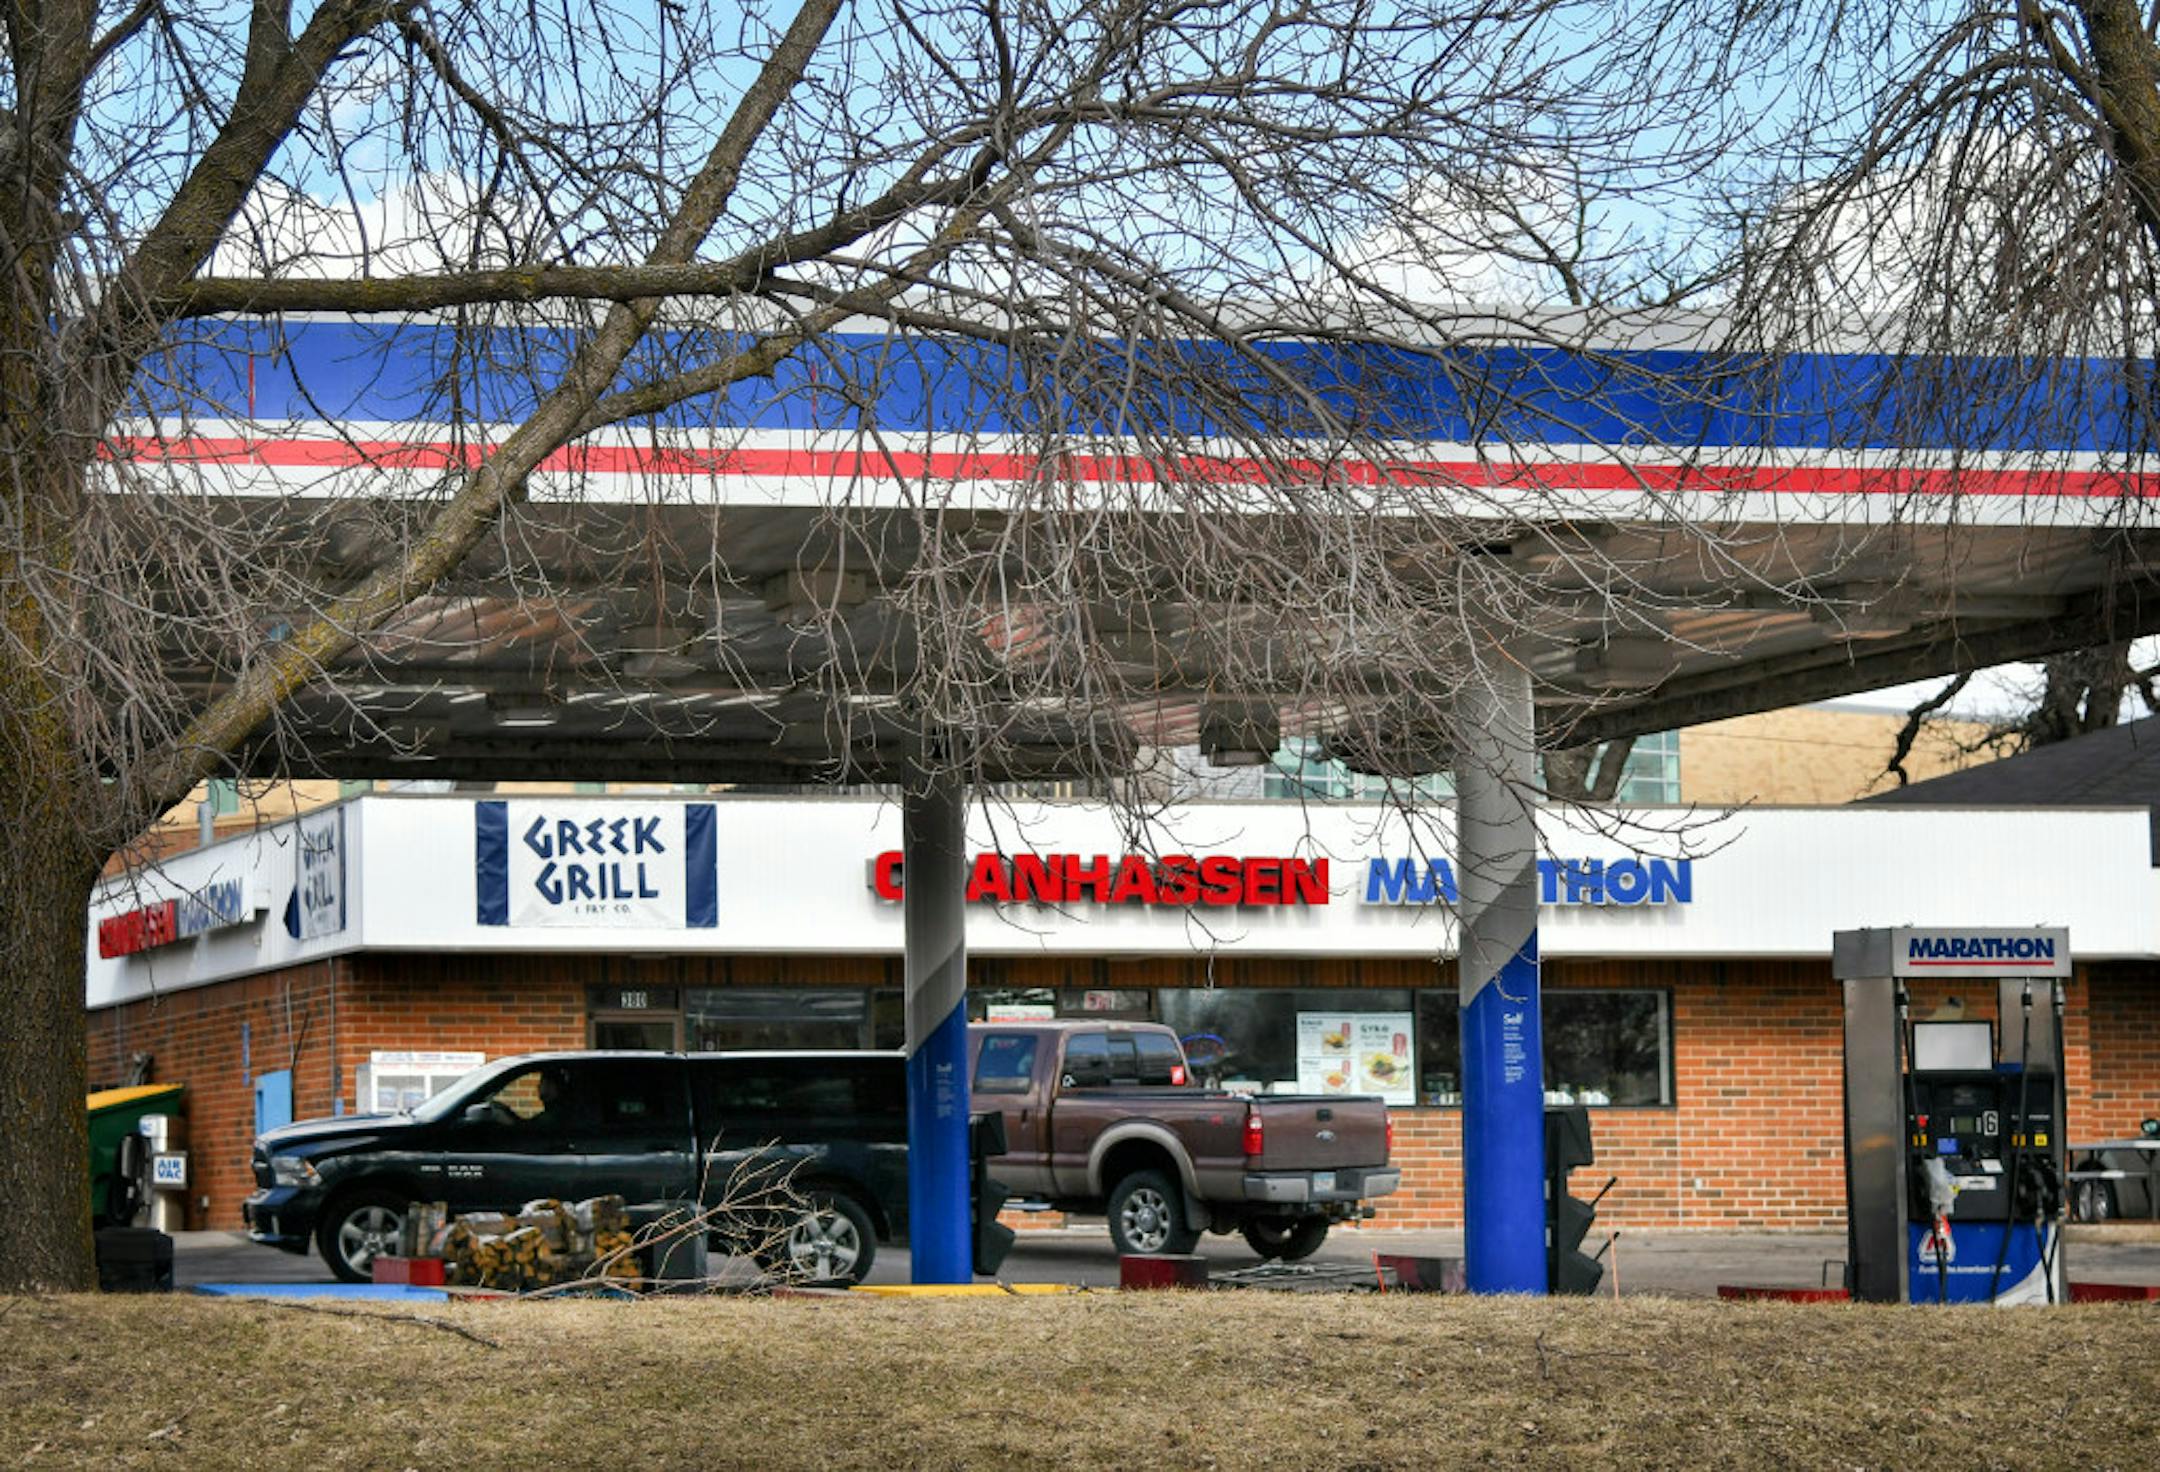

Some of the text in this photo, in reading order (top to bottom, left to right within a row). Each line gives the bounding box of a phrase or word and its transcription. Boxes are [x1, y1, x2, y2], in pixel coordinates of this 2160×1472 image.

[523, 815, 666, 860] GREEK
[534, 861, 659, 905] GRILL
[873, 850, 1693, 905] CANHASSEN MATHON
[1909, 937, 2055, 958] MARATHON
[158, 1159, 182, 1168] AIR
[158, 1169, 182, 1179] VAC
